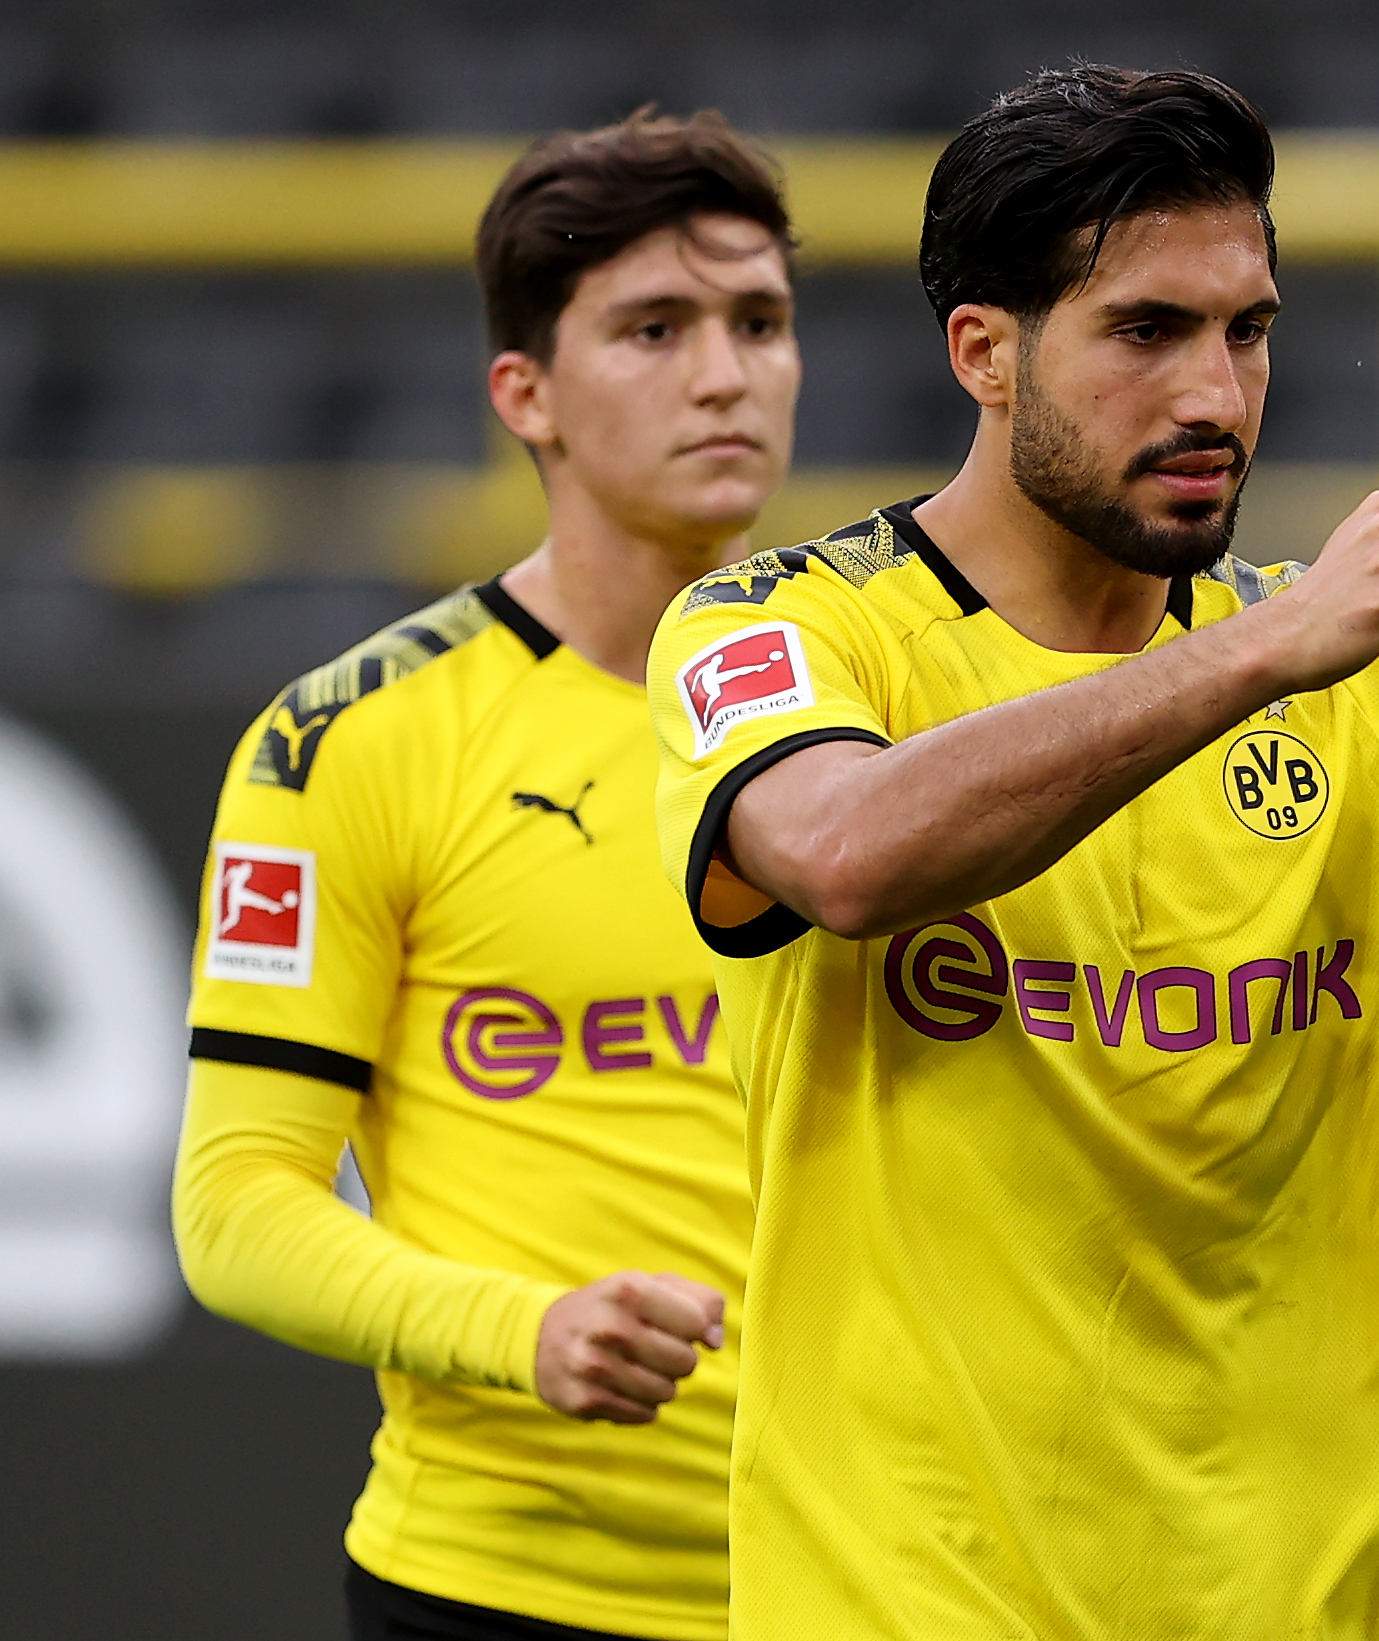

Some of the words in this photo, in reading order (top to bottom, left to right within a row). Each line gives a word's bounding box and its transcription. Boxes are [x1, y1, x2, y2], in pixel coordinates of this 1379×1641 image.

[703, 694, 800, 750] BUNDESLIGA
[1232, 739, 1319, 810] BVB
[1266, 805, 1299, 831] 09
